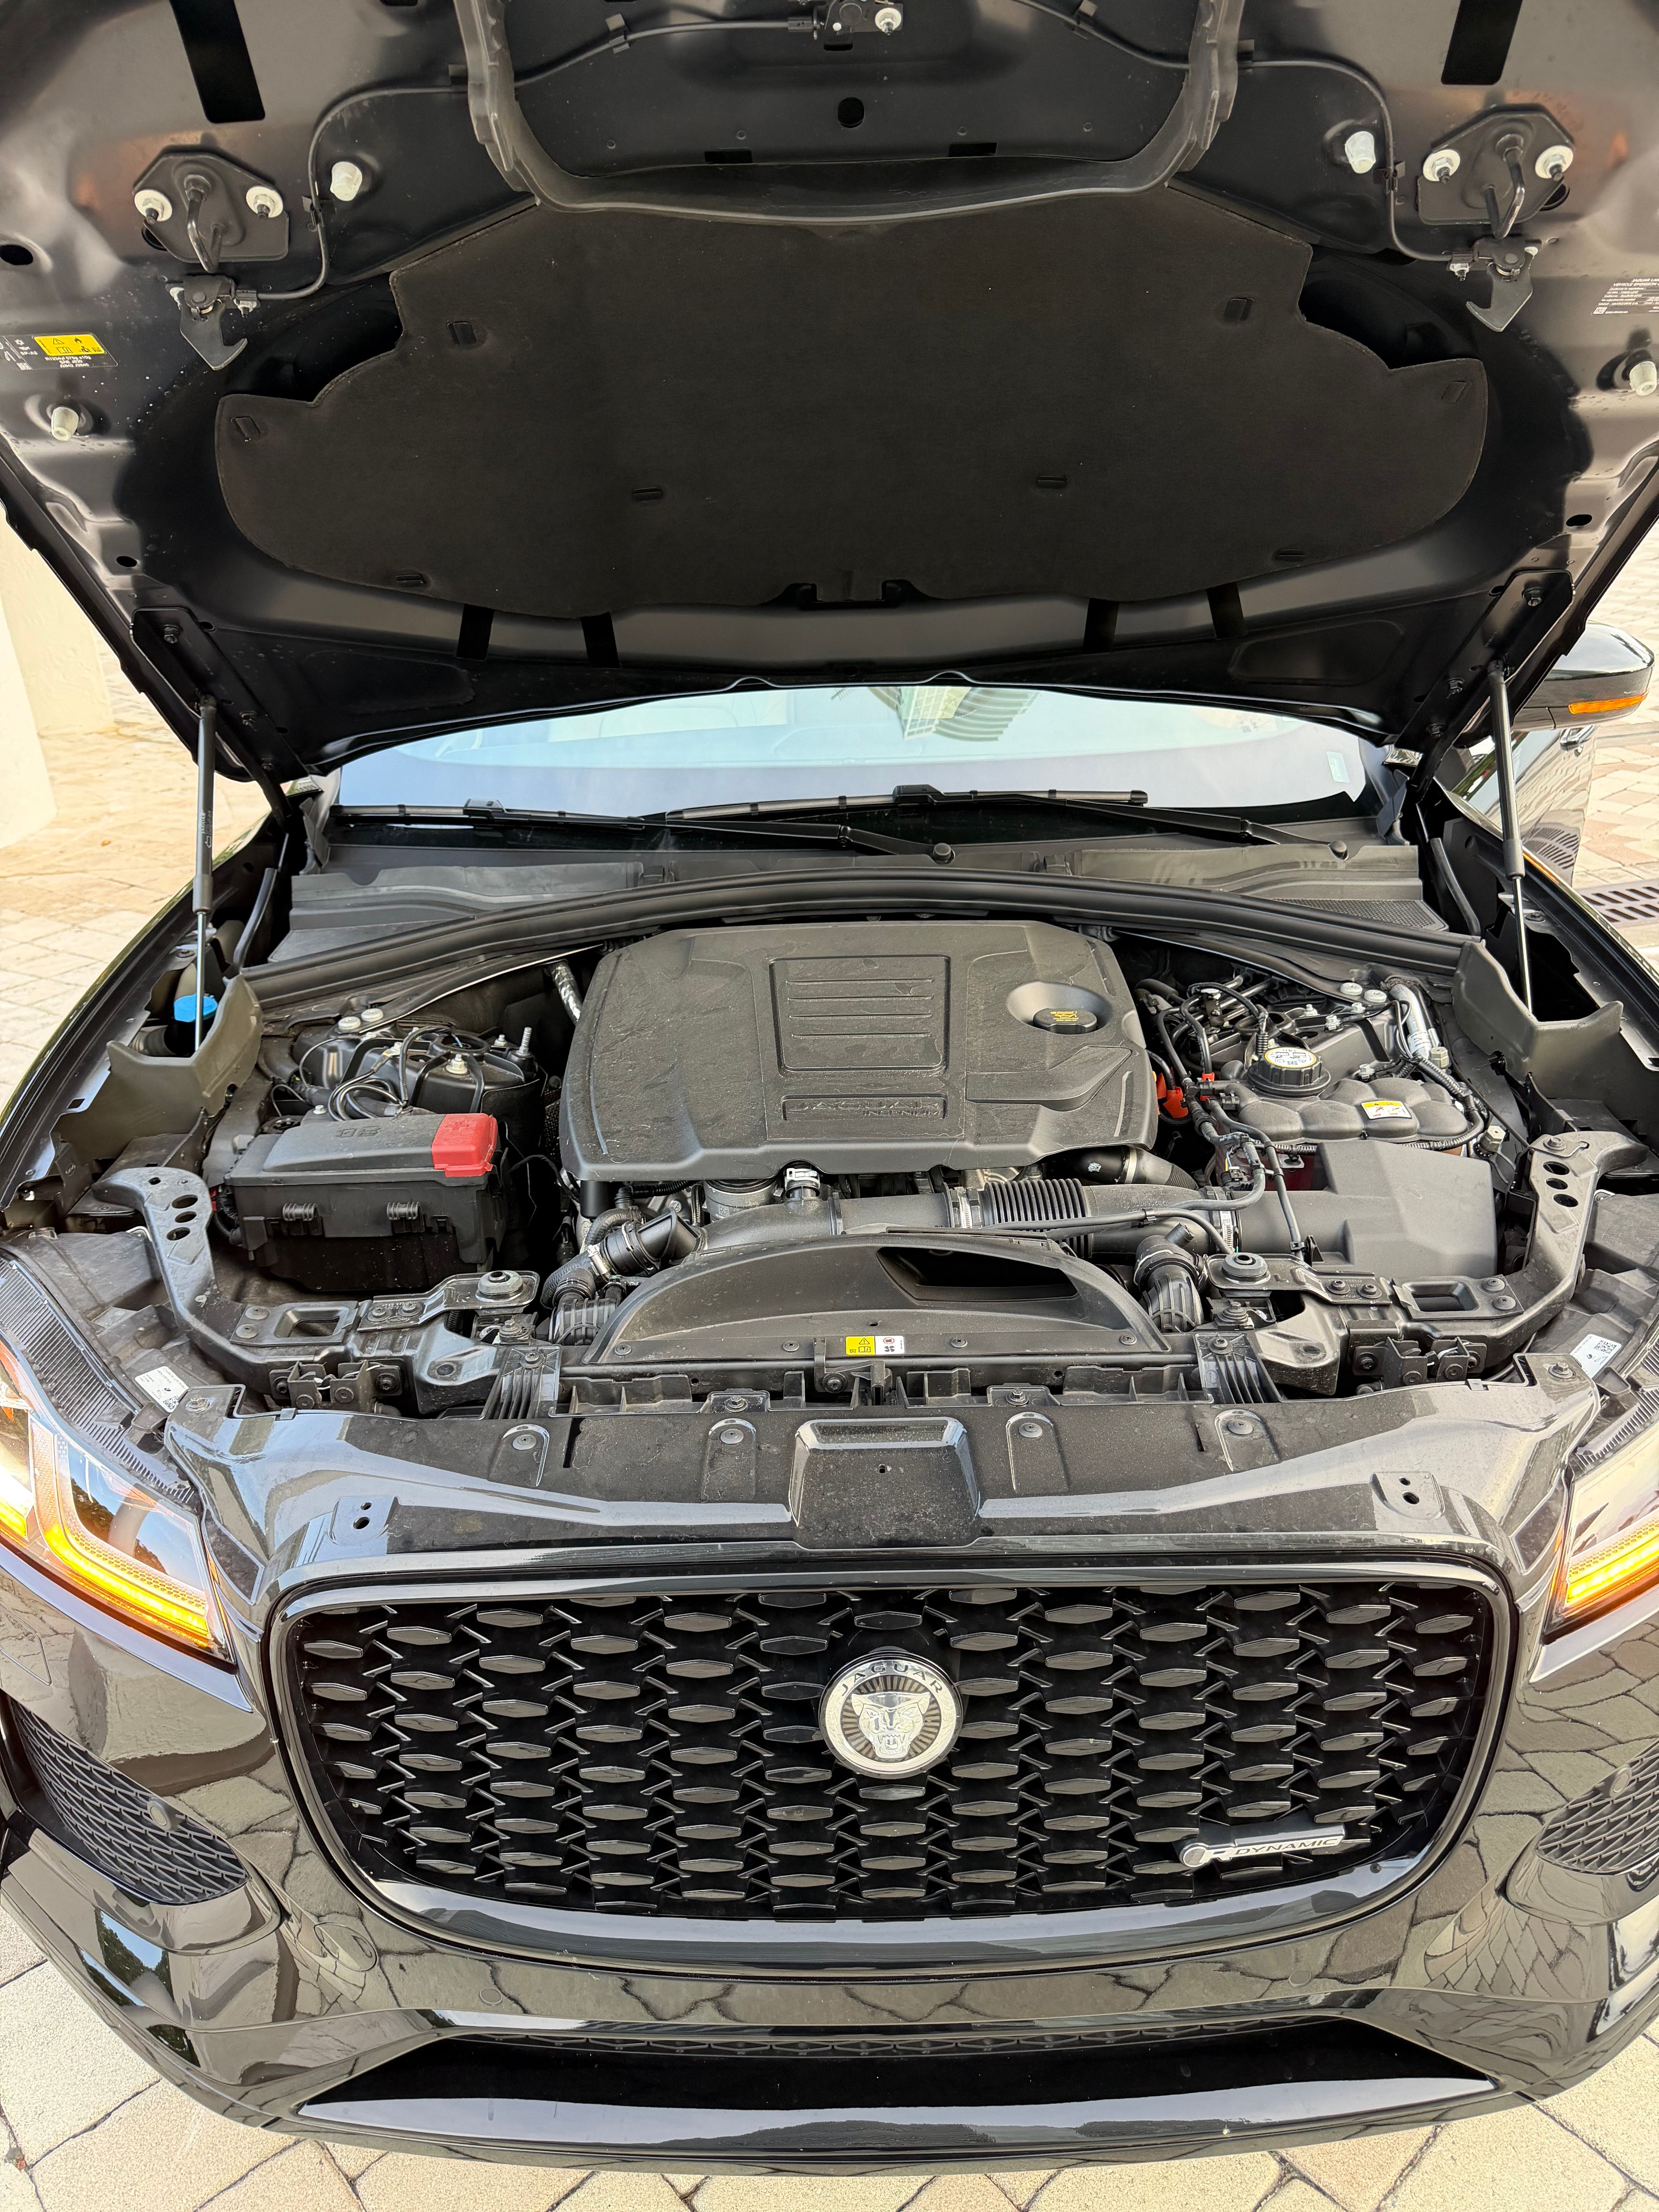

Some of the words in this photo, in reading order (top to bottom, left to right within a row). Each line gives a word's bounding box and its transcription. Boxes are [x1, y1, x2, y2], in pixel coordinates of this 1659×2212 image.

[788, 1101, 939, 1111] JAGUAR
[841, 1664, 943, 1697] JAGUAR
[1235, 1838, 1339, 1856] DYNAMIC
